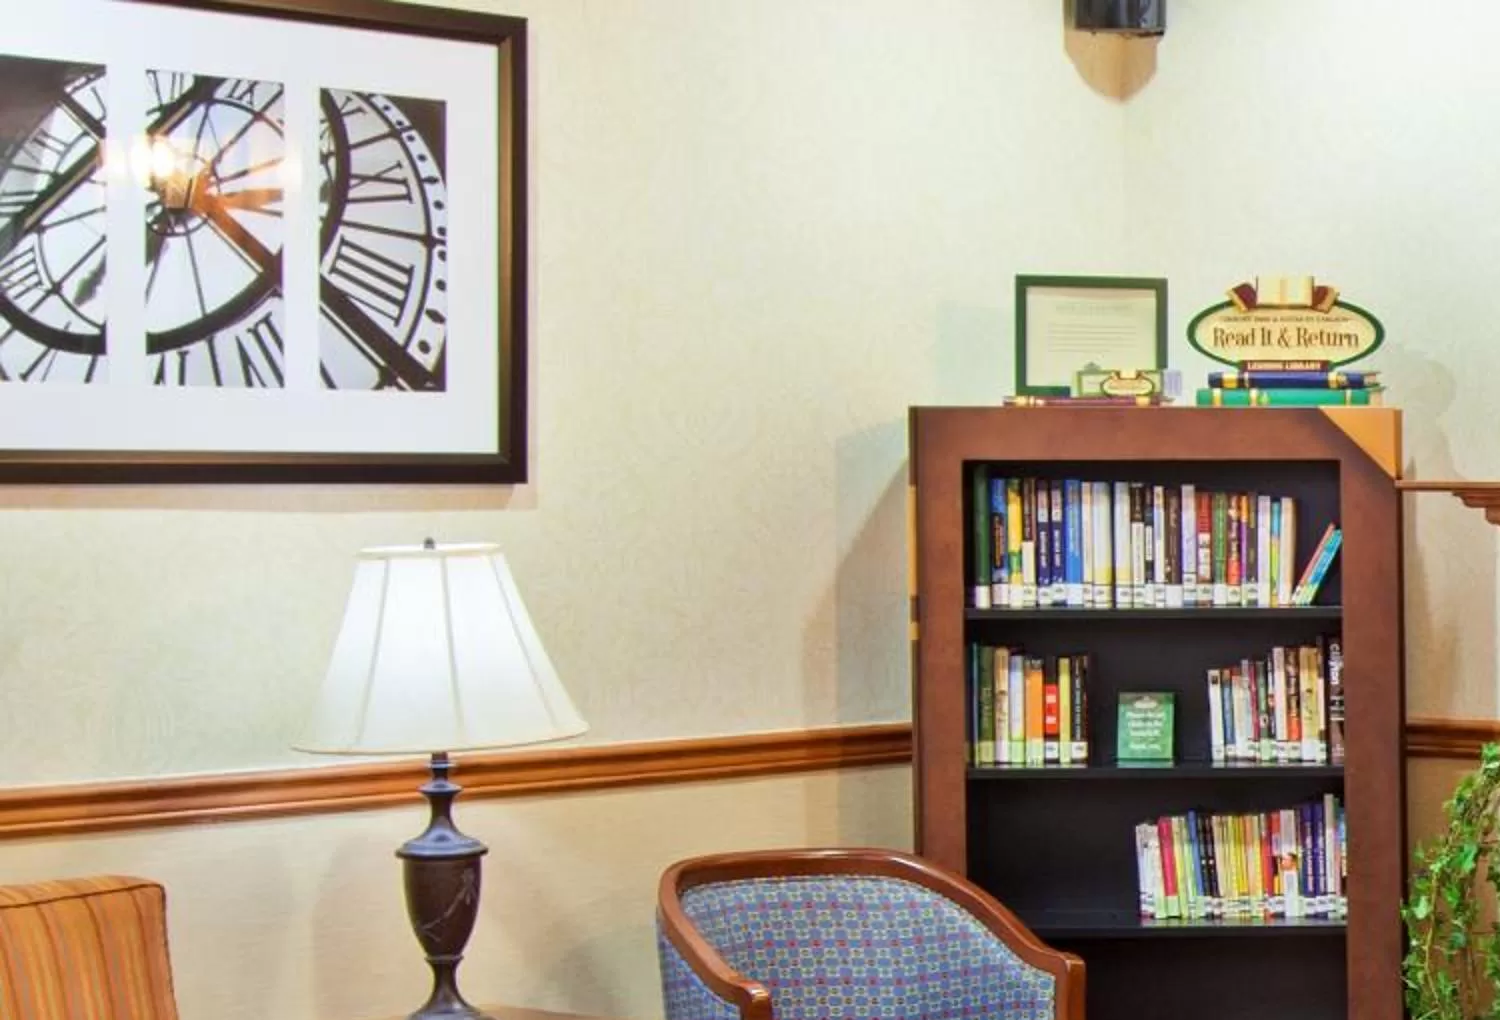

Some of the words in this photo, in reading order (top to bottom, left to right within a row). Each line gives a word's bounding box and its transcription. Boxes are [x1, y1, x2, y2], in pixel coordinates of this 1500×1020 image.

[1213, 326, 1256, 348] Read
[1260, 327, 1272, 347] It
[1277, 327, 1290, 348] &
[1296, 326, 1360, 348] Return
